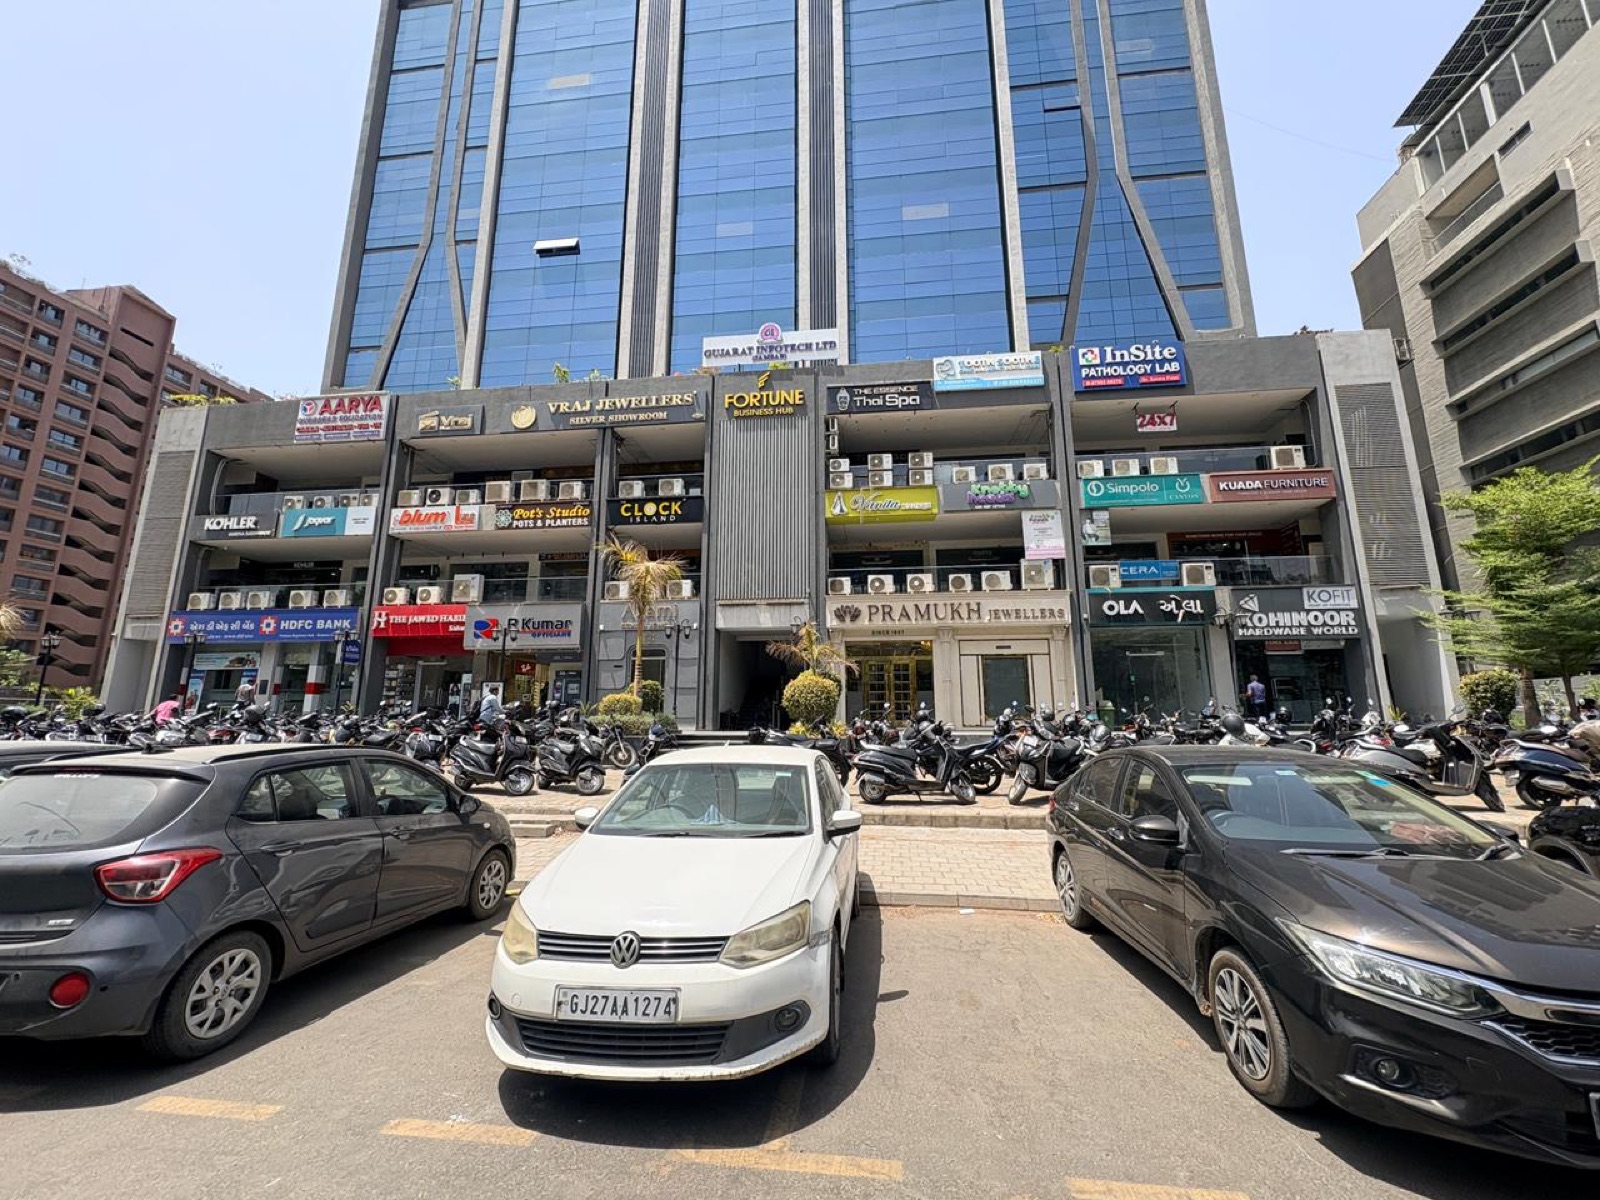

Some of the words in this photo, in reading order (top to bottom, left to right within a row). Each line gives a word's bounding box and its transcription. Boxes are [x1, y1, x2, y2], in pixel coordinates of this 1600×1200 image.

[704, 345, 753, 359] GUJARAT
[756, 342, 812, 355] INFOTECH
[815, 340, 836, 350] LTD
[1104, 341, 1176, 362] InSite
[1081, 363, 1151, 377] PATHOLOGY
[1155, 362, 1180, 372] LAB
[853, 387, 871, 395] THE
[873, 385, 919, 393] ESSENCE
[319, 395, 384, 415] AARYA
[548, 400, 591, 413] VRAJ
[595, 393, 694, 411] JEWELLERS
[724, 389, 805, 408] FORTUNE
[853, 395, 883, 407] Thai
[885, 394, 920, 408] Spa
[569, 415, 605, 425] SILVER
[608, 411, 668, 423] SHOWROOM
[733, 408, 773, 417] BUSINESS
[775, 407, 794, 415] HUB
[1106, 481, 1159, 495] Simpolo
[1219, 480, 1262, 491] KUADA
[1264, 477, 1329, 489] FURNITURE
[513, 507, 543, 519] Pot's
[546, 505, 590, 518] Studio
[620, 501, 682, 516] CLOCK
[204, 516, 257, 530] KOHLER
[399, 509, 447, 525] blum
[513, 519, 534, 528] POTS
[535, 519, 543, 527] &
[545, 518, 589, 527] PLANTERS
[1120, 566, 1159, 575] CERA
[1306, 589, 1353, 603] KOFIT
[867, 602, 982, 622] PRAMUKH
[987, 608, 1065, 621] JEWELLERS
[1102, 599, 1145, 616] OLA
[280, 619, 313, 630] HDFC
[316, 619, 351, 630] BANK
[389, 615, 407, 623] THE
[407, 615, 439, 625] JAWED
[521, 618, 573, 630] Kumar
[531, 630, 572, 638] OPTICIANS
[1238, 627, 1307, 636] HARDWARE
[1311, 625, 1359, 635] WORLD
[570, 994, 672, 1017] GJ27AA1274
